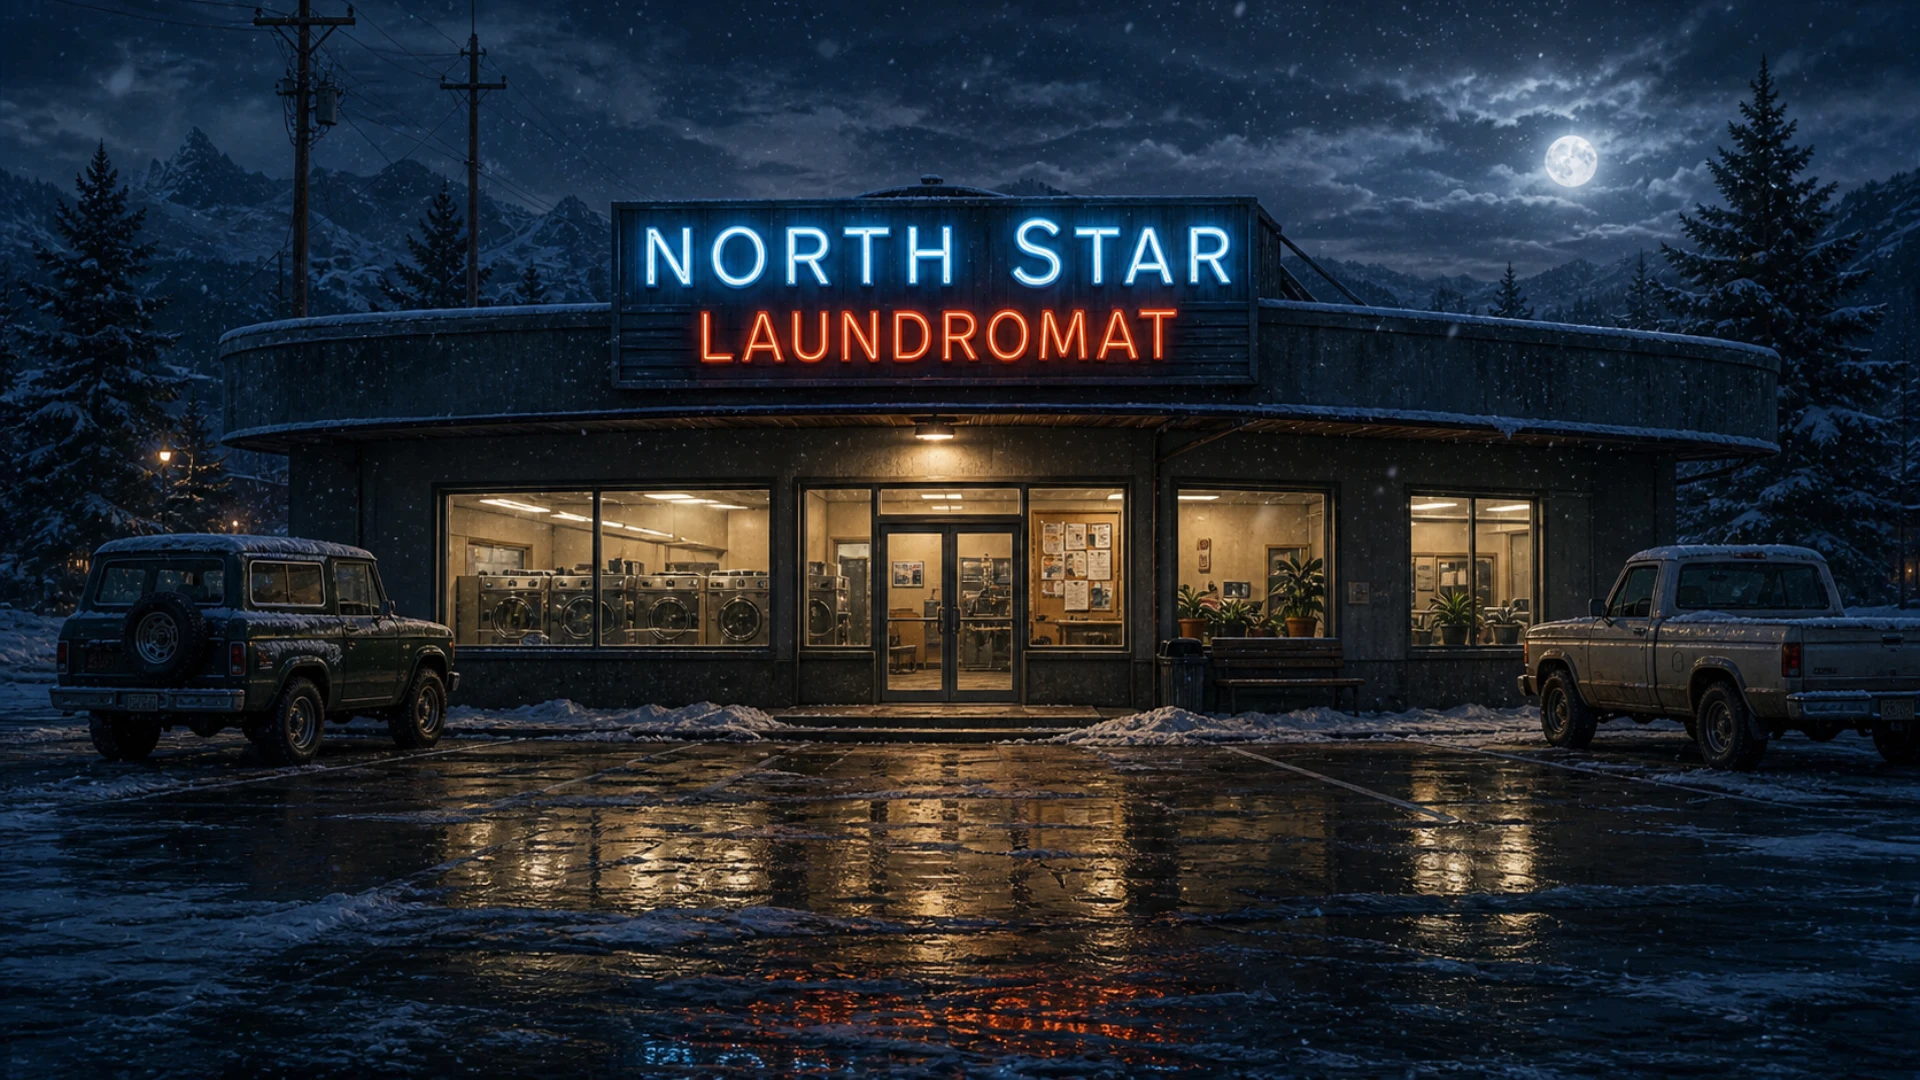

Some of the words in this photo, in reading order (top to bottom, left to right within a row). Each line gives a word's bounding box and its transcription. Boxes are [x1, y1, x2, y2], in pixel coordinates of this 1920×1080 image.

[645, 226, 953, 287] NORTH
[1012, 218, 1232, 288] STAR
[700, 308, 1178, 363] LAUNDROMAT
